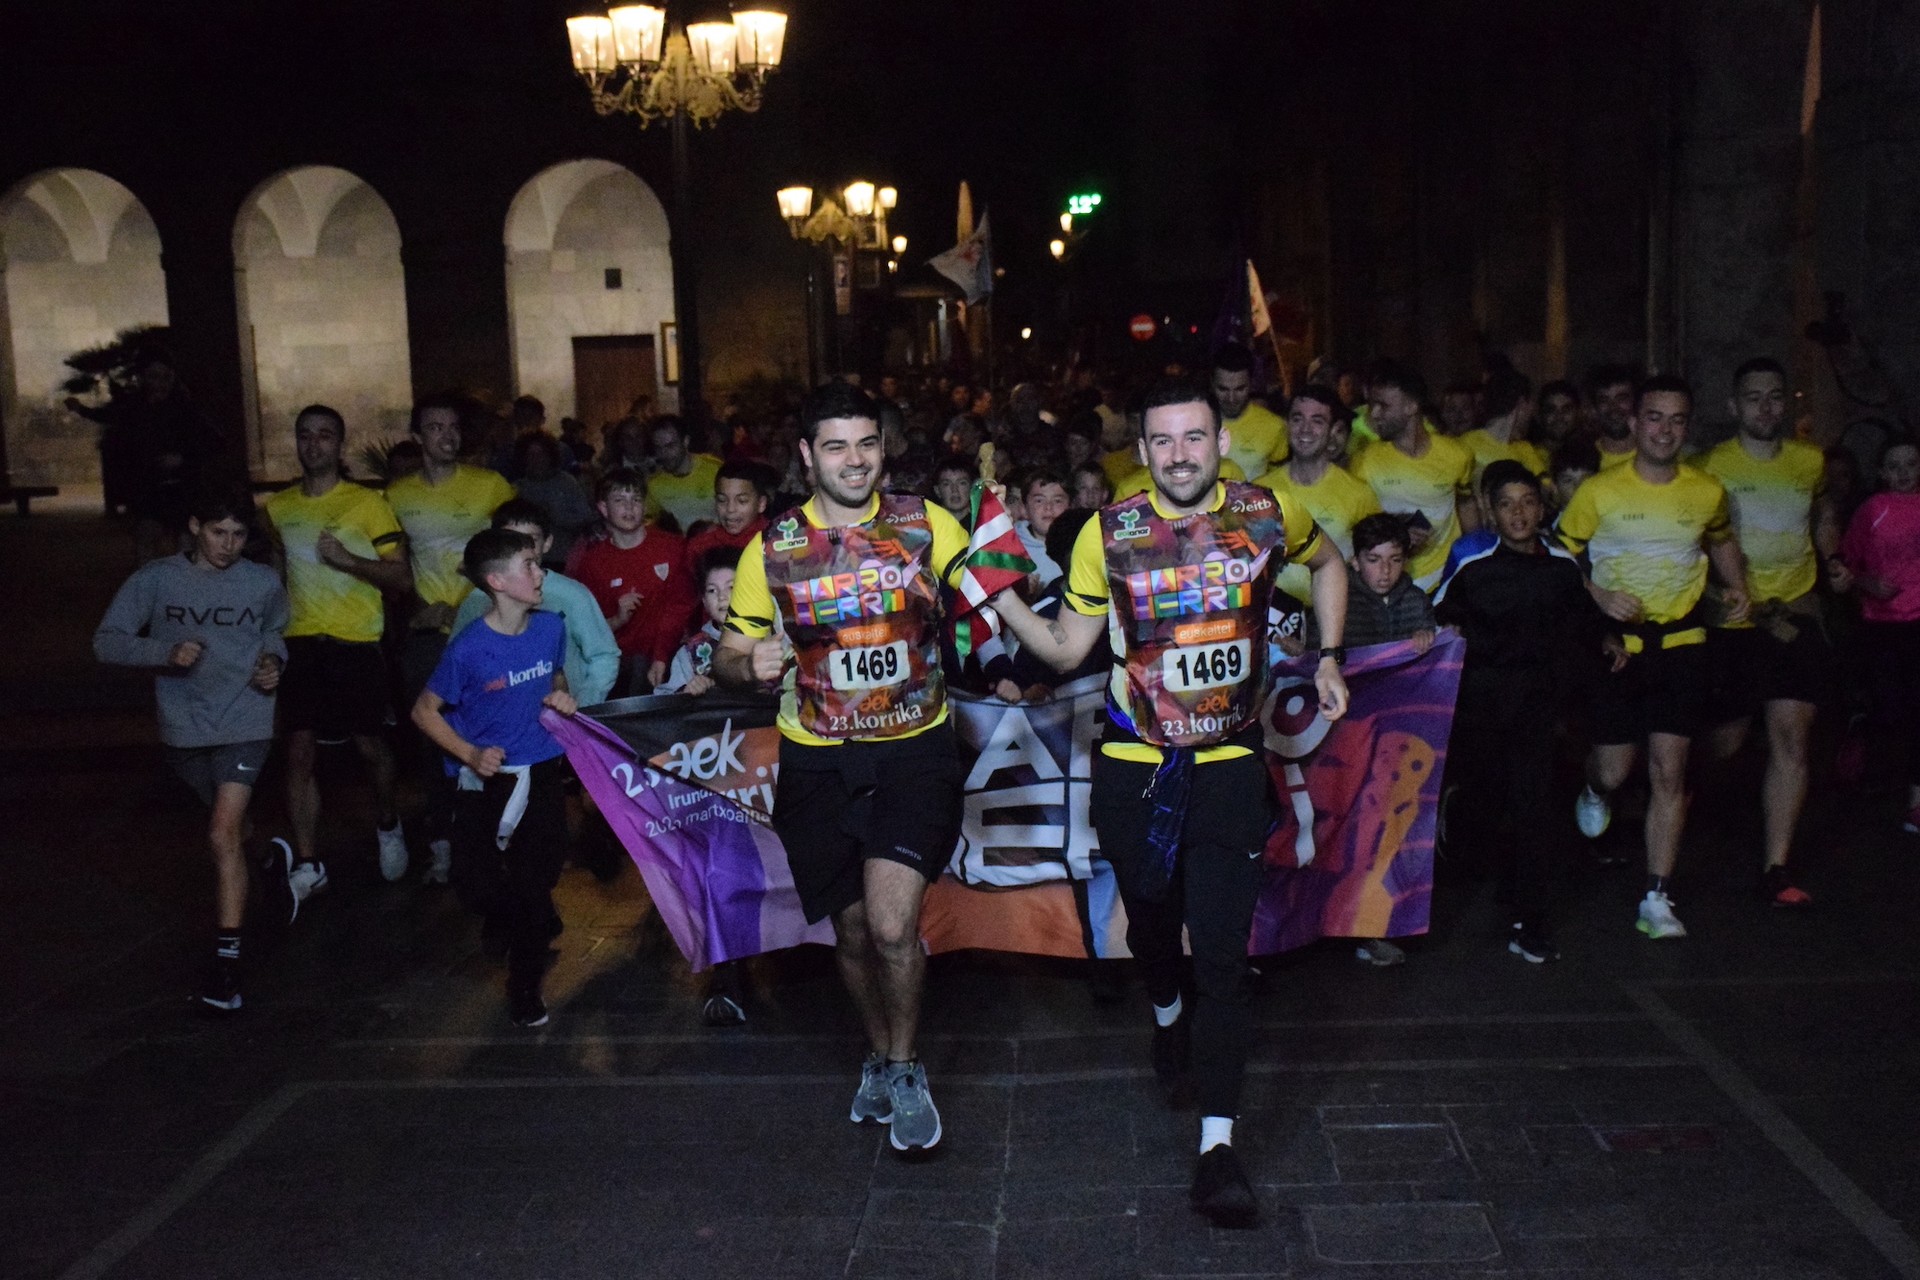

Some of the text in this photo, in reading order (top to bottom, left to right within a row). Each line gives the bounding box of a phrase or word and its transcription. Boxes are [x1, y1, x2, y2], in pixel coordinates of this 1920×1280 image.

[900, 512, 924, 523] eitb
[1246, 498, 1272, 512] eitb
[165, 605, 256, 626] RVCA
[1179, 621, 1232, 640] euskaltel
[508, 659, 553, 687] korrika
[841, 646, 898, 682] 1469
[1176, 645, 1242, 687] 1469
[859, 688, 893, 713] aek
[1196, 687, 1231, 714] aek
[829, 701, 923, 731] 23.korrika
[662, 717, 746, 780] aek
